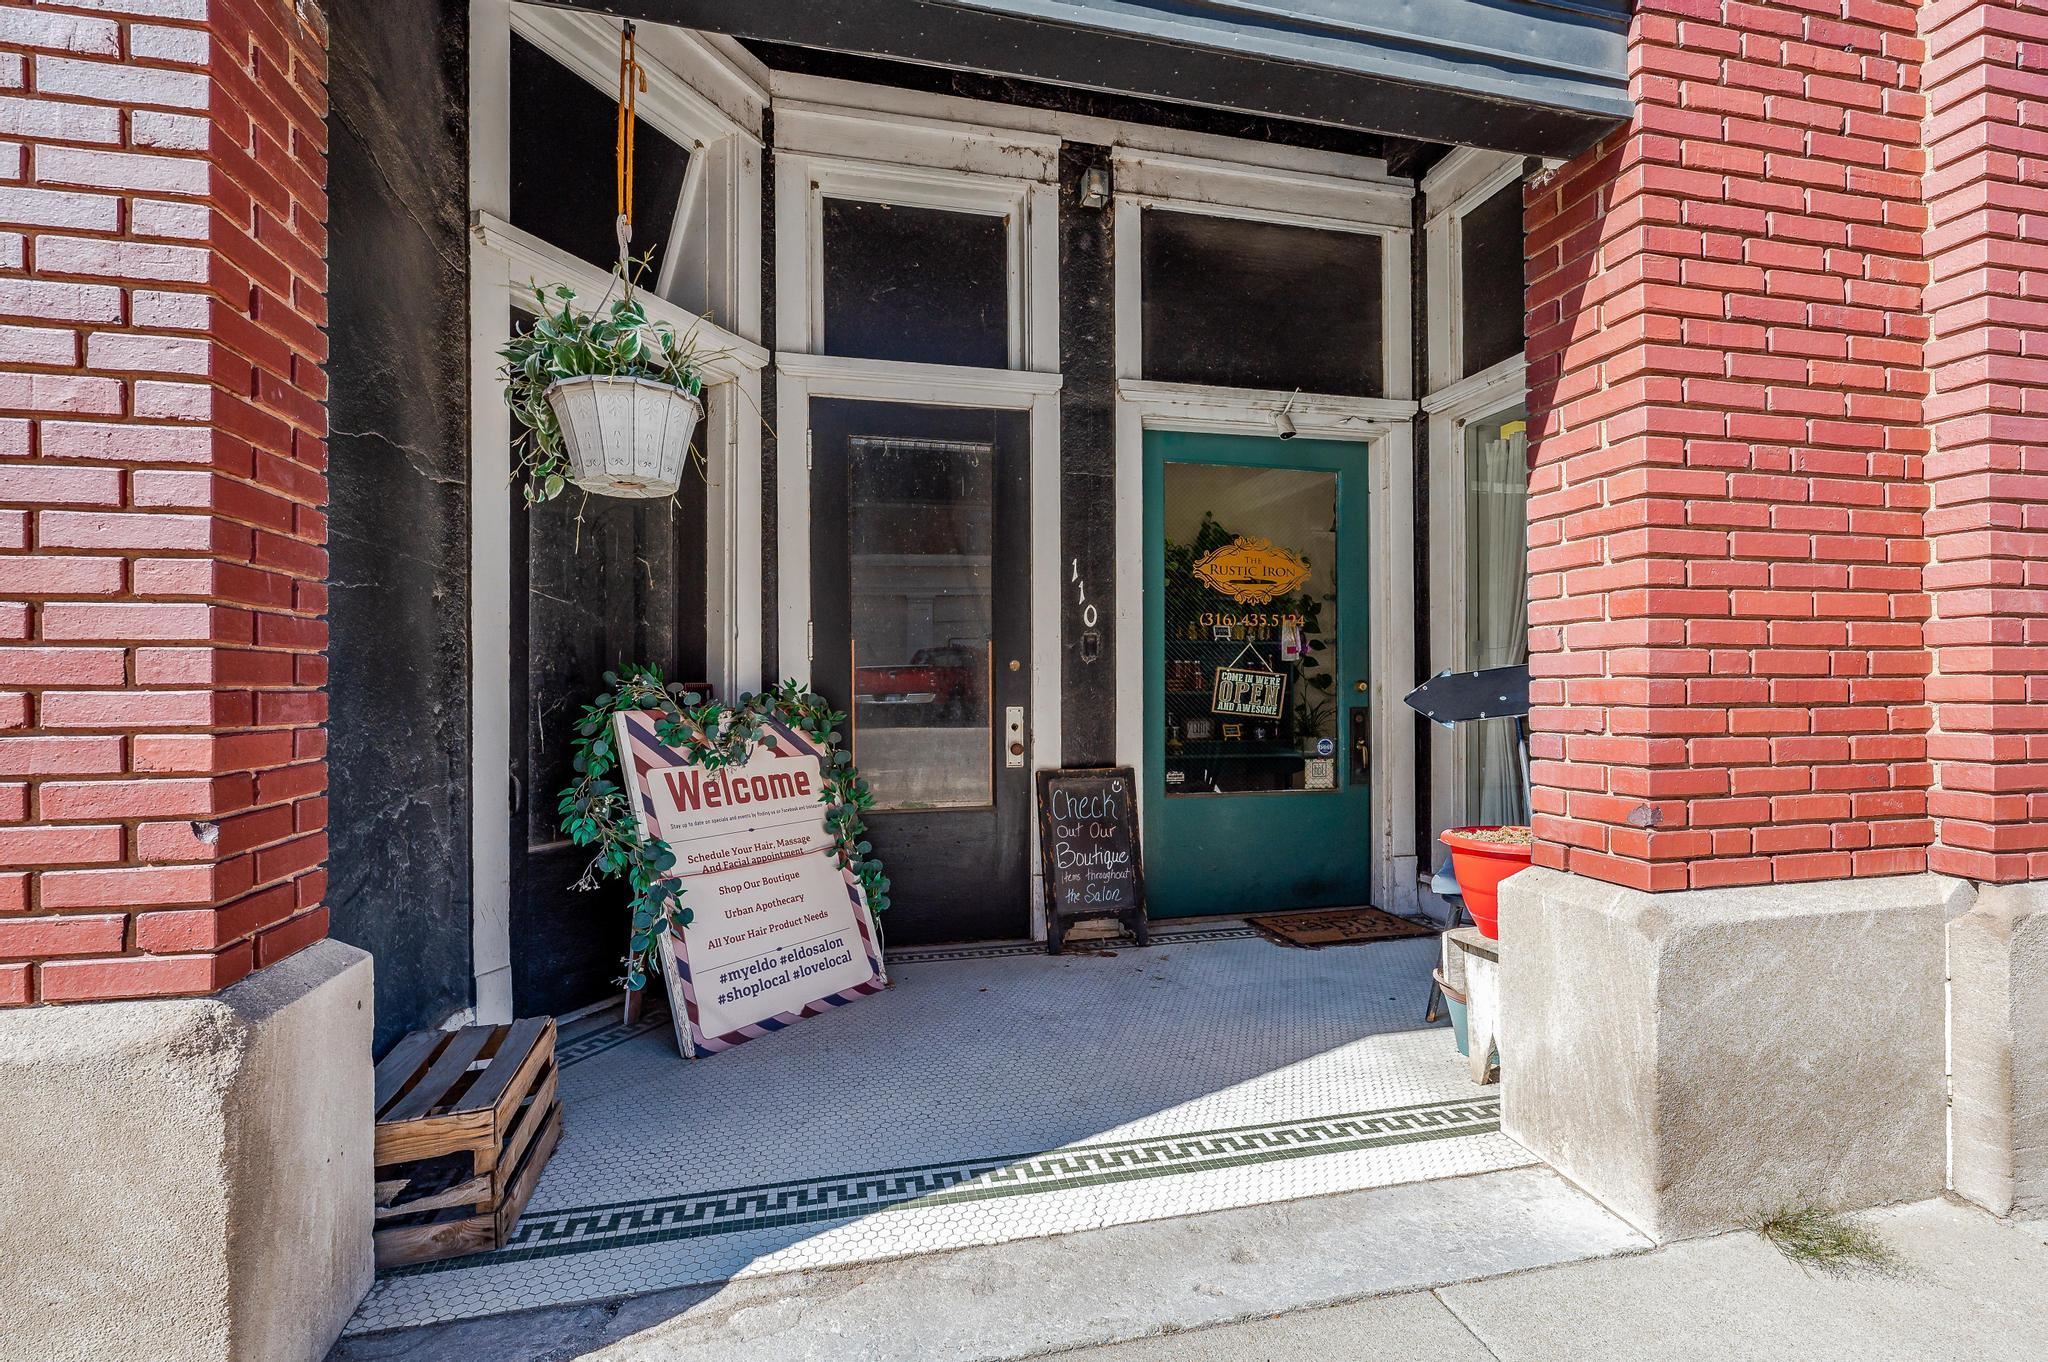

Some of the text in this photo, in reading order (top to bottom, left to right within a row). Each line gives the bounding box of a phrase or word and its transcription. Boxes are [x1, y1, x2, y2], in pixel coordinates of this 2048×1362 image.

[1210, 564, 1296, 577] RUSTIC IRON
[1200, 612, 1305, 628] (316) 435.5124
[1221, 672, 1243, 682] COME
[1245, 674, 1254, 683] IN
[1218, 680, 1280, 706] OPEN
[1217, 702, 1277, 715] AND AWESOME
[664, 768, 811, 812] Welcome
[1052, 789, 1118, 821] Check
[1056, 822, 1117, 838] Out Our
[687, 850, 731, 864] Schedule
[731, 846, 753, 856] Your
[776, 835, 811, 848] Massage
[702, 848, 805, 874] And Facial appointment
[1056, 842, 1129, 869] Boutique
[718, 871, 800, 896] Shop Our Boutique
[1087, 868, 1130, 883] throughout
[724, 893, 804, 919] Urban Apothecary
[1065, 883, 1122, 903] the Salon
[708, 910, 829, 950] All Your Hair Product Needs
[719, 937, 844, 984] #myeldo #eldosalon
[718, 950, 852, 1005] #shoplocal #lovelocal
